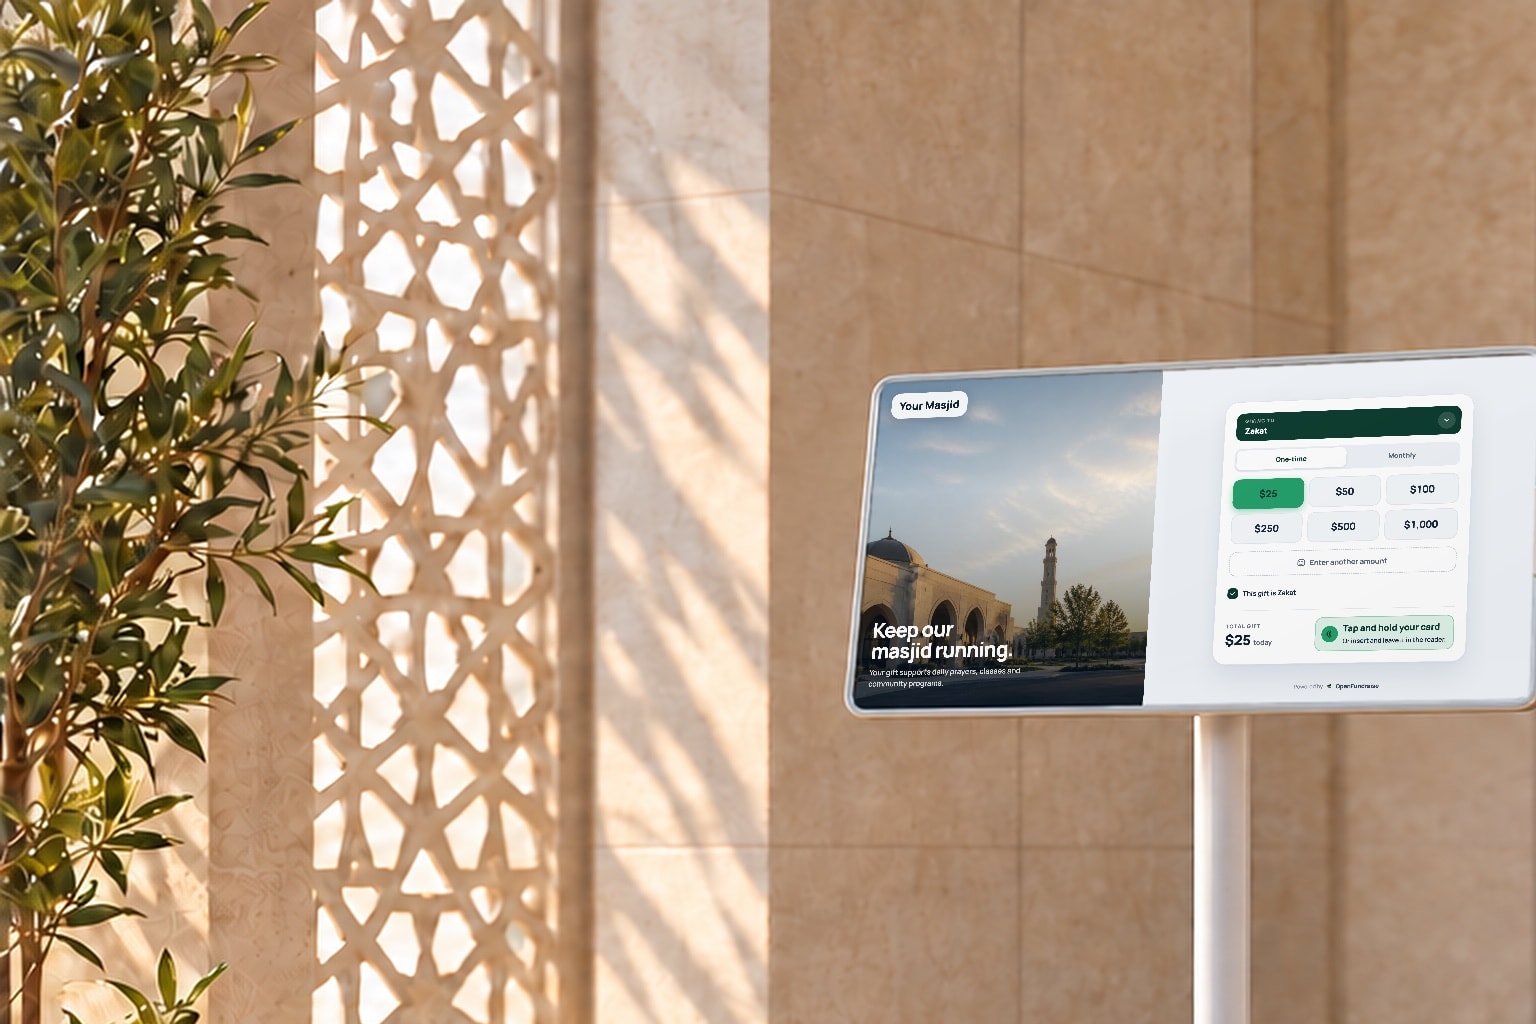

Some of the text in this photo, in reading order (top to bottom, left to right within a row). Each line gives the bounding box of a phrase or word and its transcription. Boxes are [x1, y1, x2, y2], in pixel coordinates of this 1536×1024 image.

[900, 400, 960, 411] Your Masjid
[1244, 427, 1268, 435] Zakat
[1275, 455, 1307, 463] One-time
[1388, 452, 1416, 460] Monthly
[1259, 489, 1278, 499] $25
[1335, 487, 1355, 497] $50
[1410, 484, 1435, 494] $100
[1254, 523, 1279, 533] $250
[1331, 522, 1356, 532] $500
[1404, 519, 1439, 530] $1,000
[1360, 557, 1387, 565] amount
[873, 622, 954, 642] Keep our
[1342, 624, 1358, 633] Tap
[1400, 624, 1419, 633] your
[1225, 634, 1251, 648] $25
[871, 642, 1013, 663] masjid running.
[932, 668, 948, 676] daily
